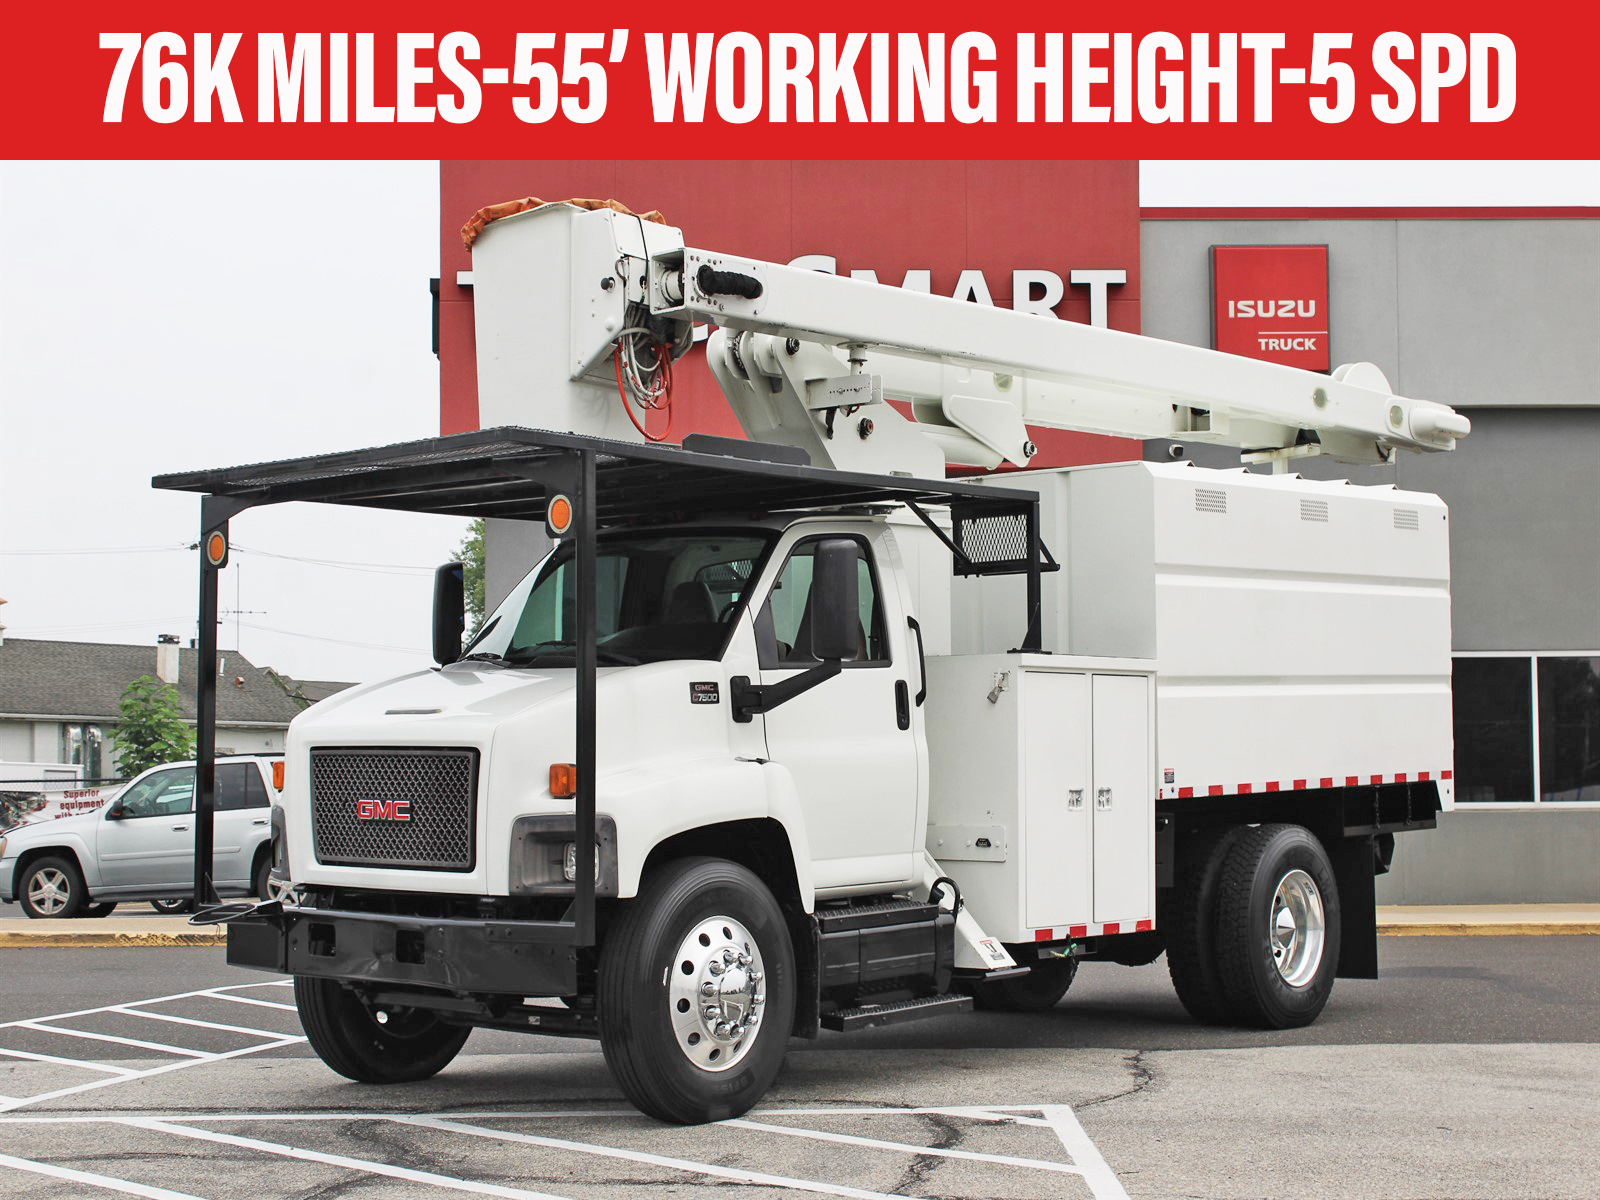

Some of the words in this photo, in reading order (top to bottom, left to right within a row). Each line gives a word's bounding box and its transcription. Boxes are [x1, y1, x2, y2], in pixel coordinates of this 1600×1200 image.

[1228, 299, 1316, 319] ISUZU
[1257, 337, 1317, 351] TRUCK
[692, 693, 718, 702] C7500
[63, 788, 100, 799] Superior
[60, 799, 104, 811] equipment
[358, 800, 410, 820] GMC
